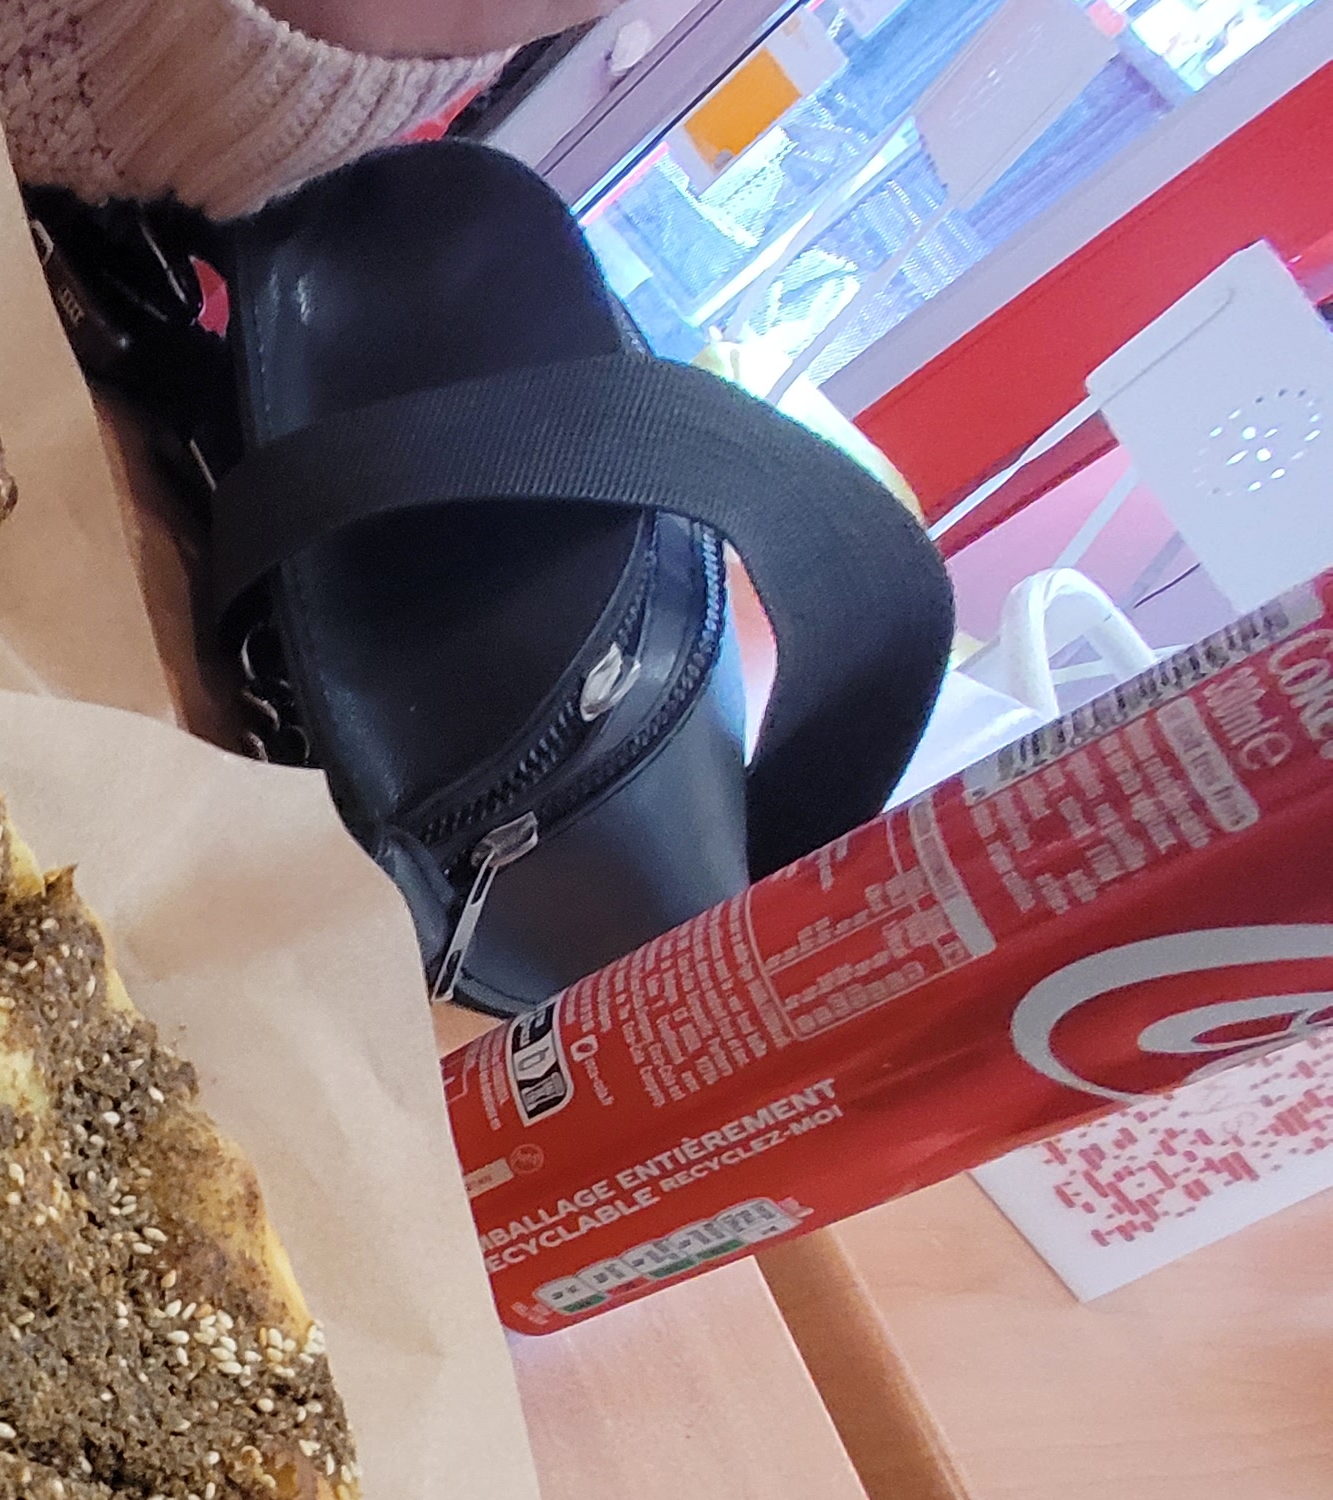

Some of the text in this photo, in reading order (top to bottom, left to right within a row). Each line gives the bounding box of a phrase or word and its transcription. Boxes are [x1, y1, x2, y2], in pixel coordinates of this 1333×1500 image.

[479, 1180, 614, 1251] BALLAGE
[620, 1078, 836, 1191] ENTIÈREMENT
[486, 1186, 661, 1272] ECYCLABLE
[659, 1104, 844, 1193] RECYCLEZ-MOI
